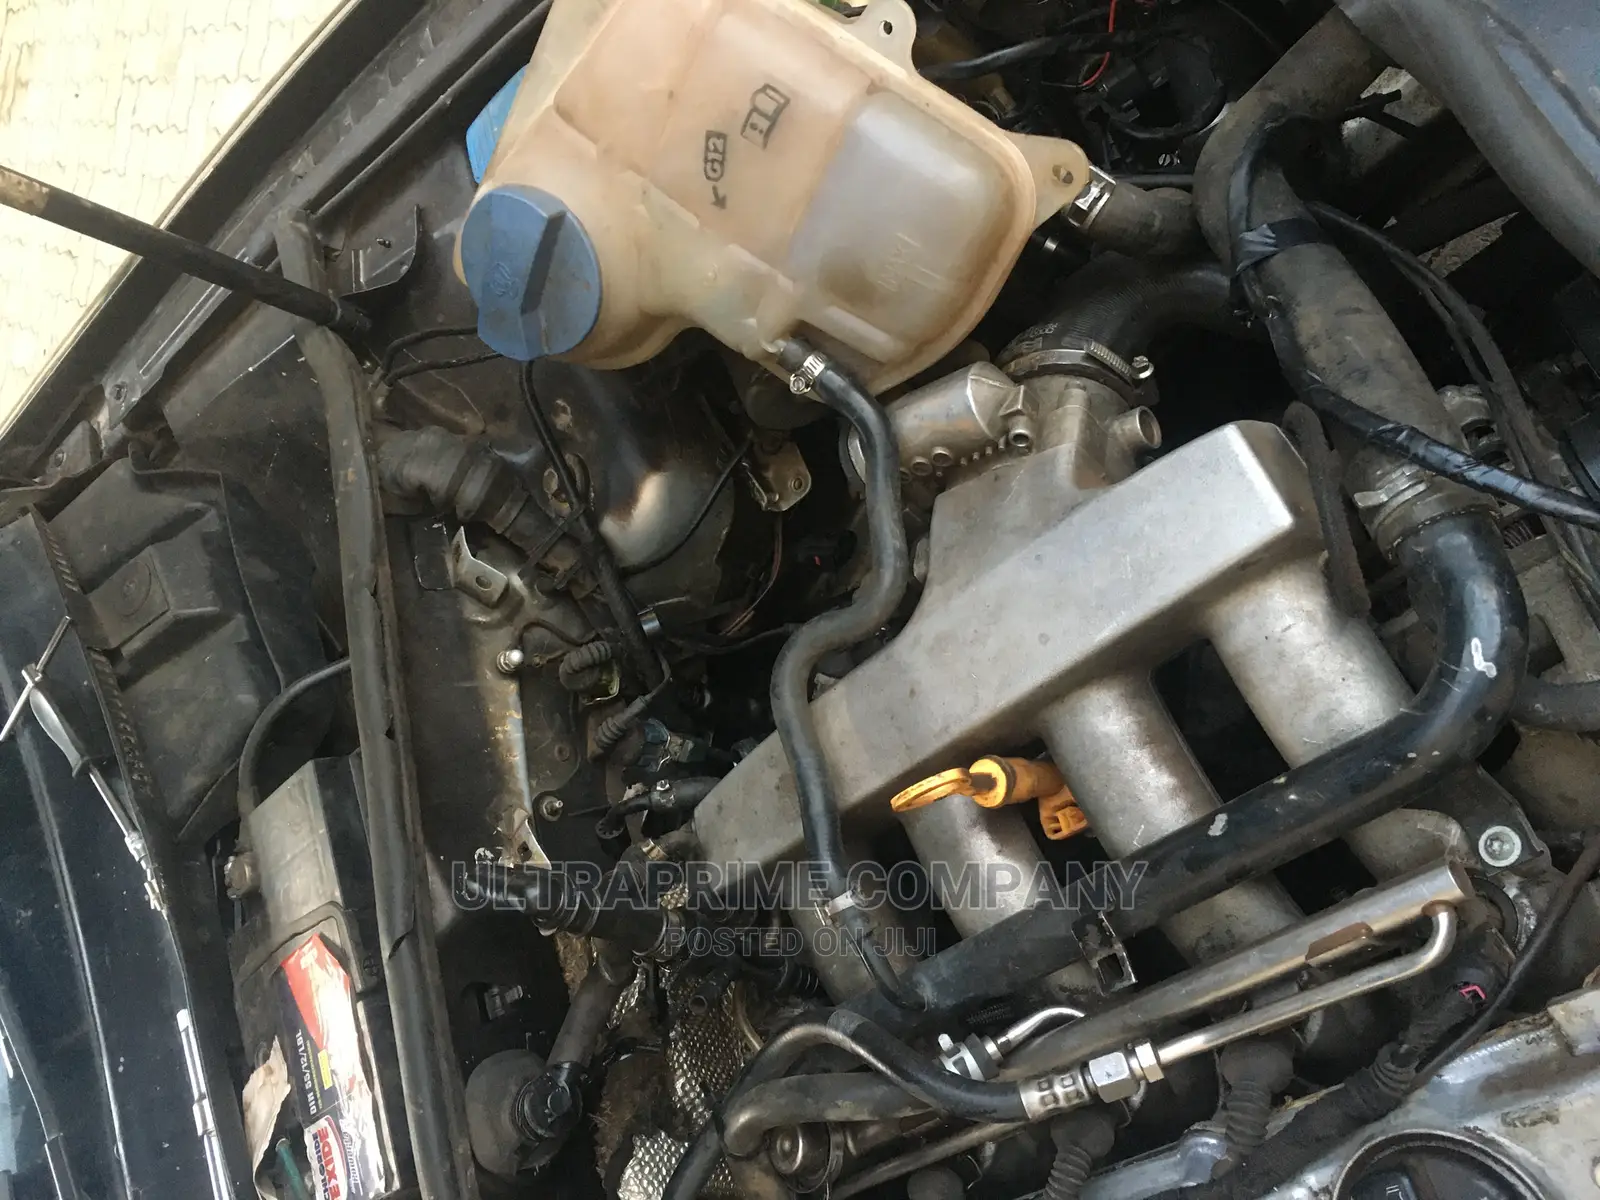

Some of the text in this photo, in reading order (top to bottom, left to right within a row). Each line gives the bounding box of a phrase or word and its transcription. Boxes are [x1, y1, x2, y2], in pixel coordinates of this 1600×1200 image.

[705, 136, 725, 180] G12
[312, 1131, 330, 1200] CHLORIDE
[317, 1126, 341, 1200] EXIDE
